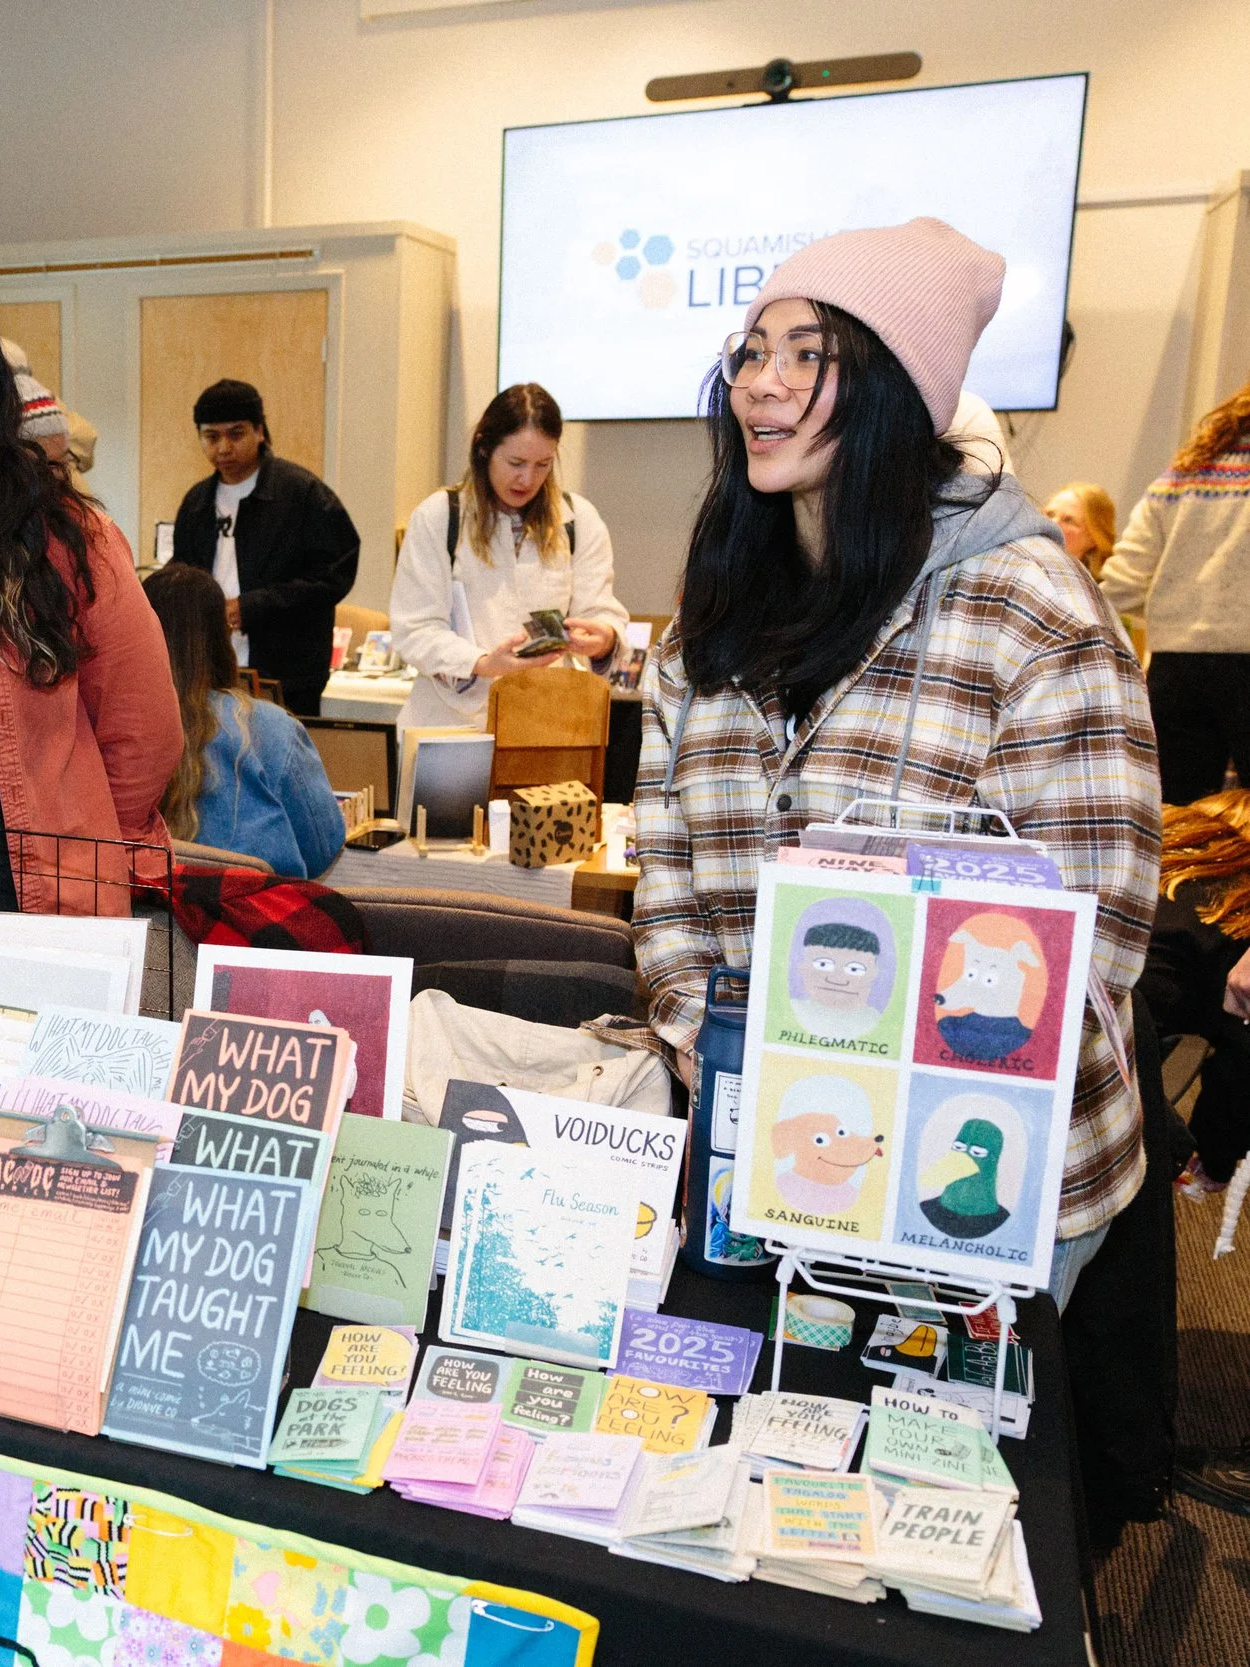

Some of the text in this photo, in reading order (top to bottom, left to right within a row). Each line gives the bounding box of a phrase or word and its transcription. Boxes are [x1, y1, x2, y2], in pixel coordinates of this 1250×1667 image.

[688, 263, 766, 308] LIB
[924, 856, 1046, 884] 2025
[29, 1014, 83, 1053] WHAT
[75, 1020, 101, 1050] MY
[95, 1023, 129, 1052] DOG
[779, 1029, 889, 1055] PHLEGMATIC
[218, 1027, 332, 1080] WHAT
[939, 1049, 1035, 1072] CHOLERIC
[180, 1068, 314, 1124] MY DOG
[554, 1114, 676, 1161] VOIDUCKS
[195, 1124, 314, 1178] WHAT
[61, 1167, 122, 1181] SIGN UP TO JOIN
[610, 1155, 669, 1172] COMIC STRIPS
[59, 1175, 74, 1184] OUR
[76, 1177, 98, 1187] EMAIL
[101, 1187, 121, 1198] LIST!
[183, 1180, 297, 1236] WHAT
[542, 1188, 620, 1216] Flu Season
[764, 1207, 861, 1233] SANGUINE
[142, 1227, 277, 1287] MY DOG
[900, 1231, 1029, 1262] MELANCHOLIC
[136, 1275, 278, 1339] TAUGHT
[342, 1332, 382, 1343] HOW
[347, 1344, 379, 1353] ARE
[629, 1328, 735, 1364] 2025
[120, 1323, 193, 1379] ME
[343, 1354, 376, 1364] YOU
[625, 1349, 731, 1374] FAVOURITES
[435, 1366, 492, 1382] ARE YOU
[443, 1358, 476, 1370] HOW
[527, 1368, 563, 1383] How
[115, 1383, 125, 1392] a
[432, 1375, 493, 1395] FEELING
[542, 1386, 574, 1399] are
[614, 1380, 697, 1404] HOW
[165, 1407, 178, 1418] CO
[296, 1397, 358, 1414] DOGS
[525, 1395, 563, 1409] you
[781, 1399, 828, 1410] HOW
[884, 1397, 959, 1421] HOW TO
[298, 1412, 347, 1423] at the
[513, 1403, 571, 1427] feeling?
[607, 1403, 660, 1426] YOU
[787, 1410, 823, 1421] YOU
[888, 1414, 959, 1434] MAKE
[286, 1423, 347, 1437] PARK
[597, 1414, 686, 1446] FEELING
[767, 1416, 848, 1440] FEELING
[888, 1425, 946, 1447] YOUR
[886, 1437, 929, 1453] OWN
[884, 1445, 971, 1473] MINI ZINE
[902, 1503, 983, 1526] TRAIN
[889, 1521, 986, 1547] PEOPLE
